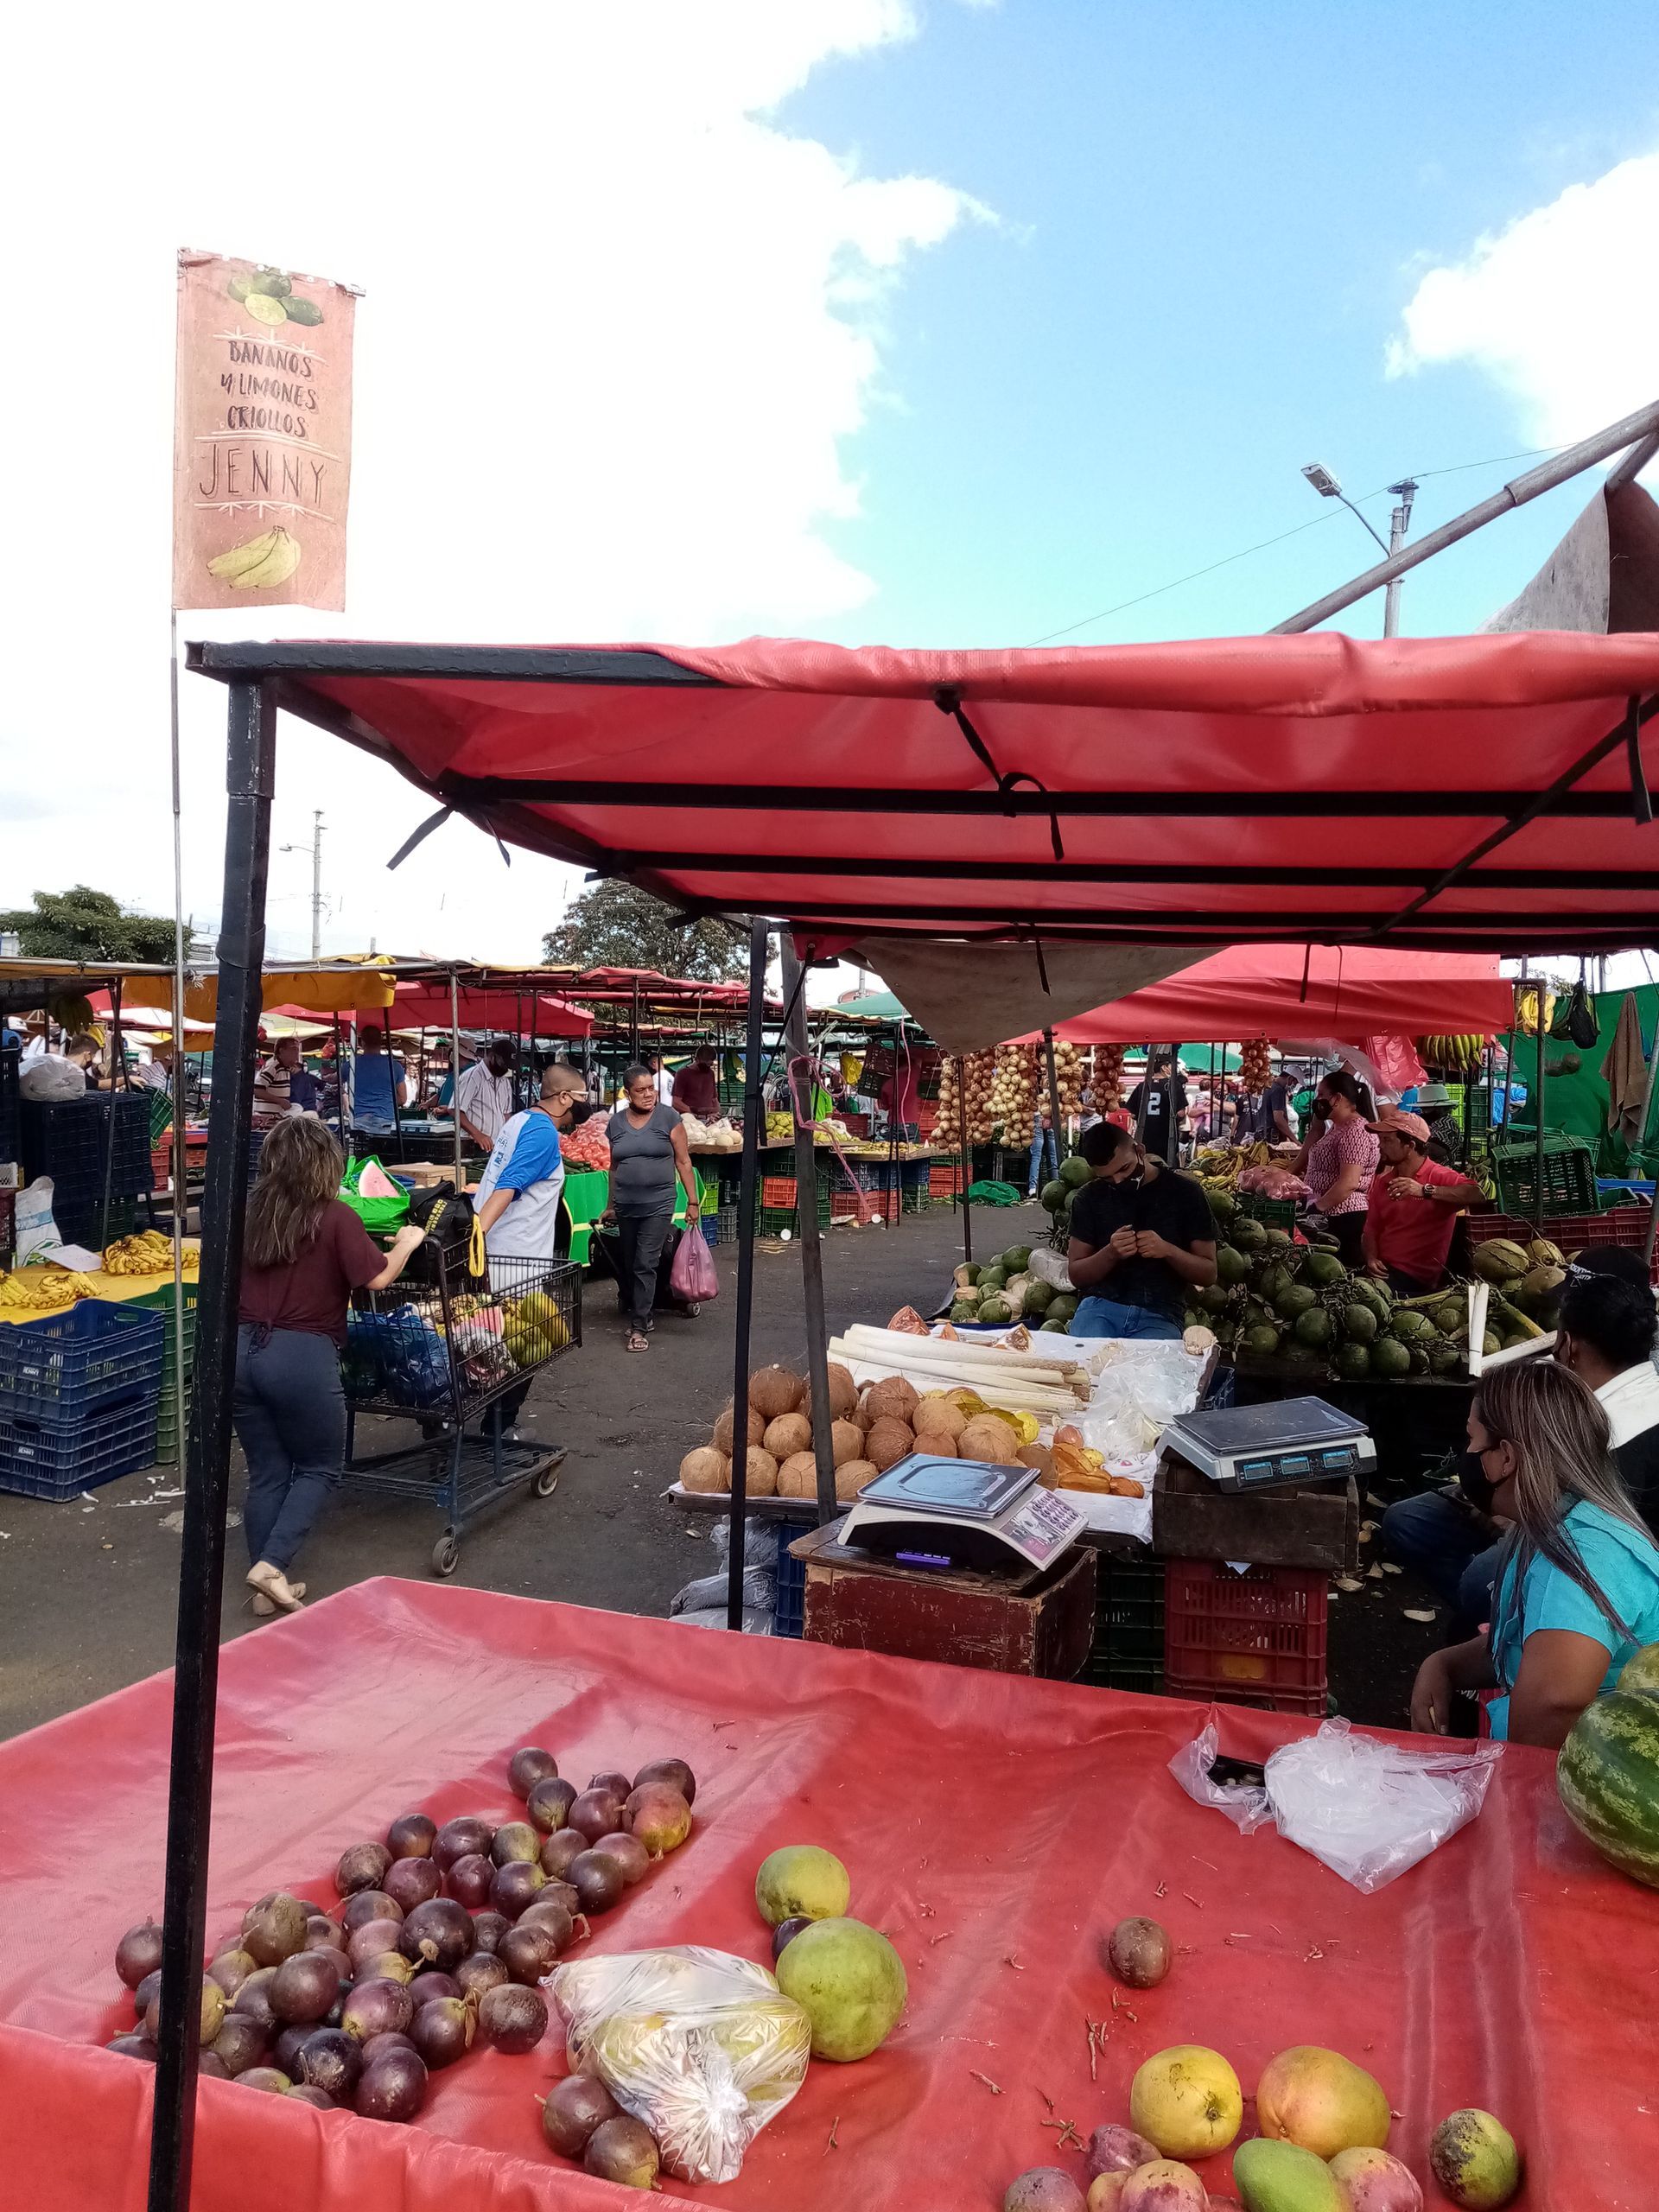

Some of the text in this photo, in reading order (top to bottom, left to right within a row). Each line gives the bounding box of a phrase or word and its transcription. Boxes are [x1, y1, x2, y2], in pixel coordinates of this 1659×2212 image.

[228, 340, 312, 378] BANANOS
[239, 373, 317, 410] LIMONES
[226, 405, 306, 437] CRIOLLOS
[199, 443, 324, 503] JENNY
[1147, 1092, 1161, 1116] 2
